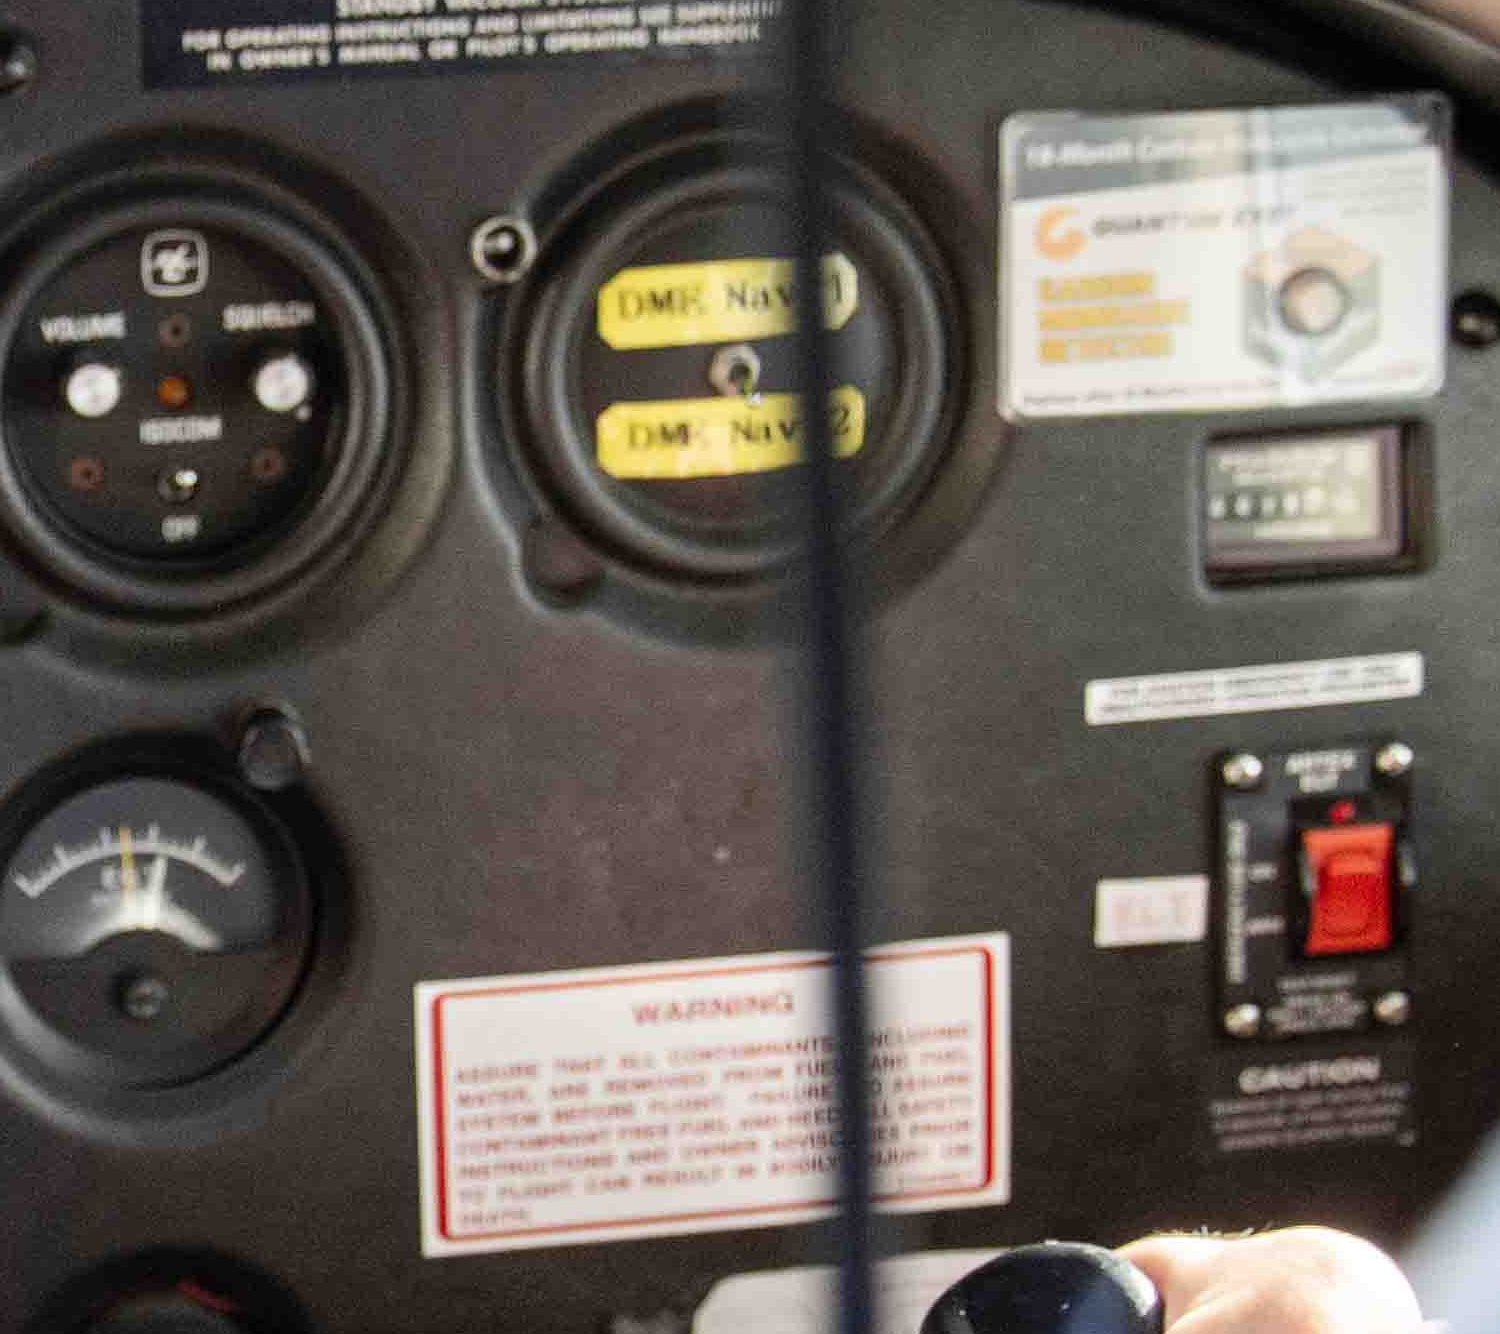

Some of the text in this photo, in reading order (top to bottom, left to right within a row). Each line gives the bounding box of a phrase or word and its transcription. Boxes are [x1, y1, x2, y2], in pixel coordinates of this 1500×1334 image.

[722, 279, 797, 310] Nav
[730, 416, 803, 446] Nav
[829, 405, 852, 438] 2
[631, 992, 794, 1026] WARNING
